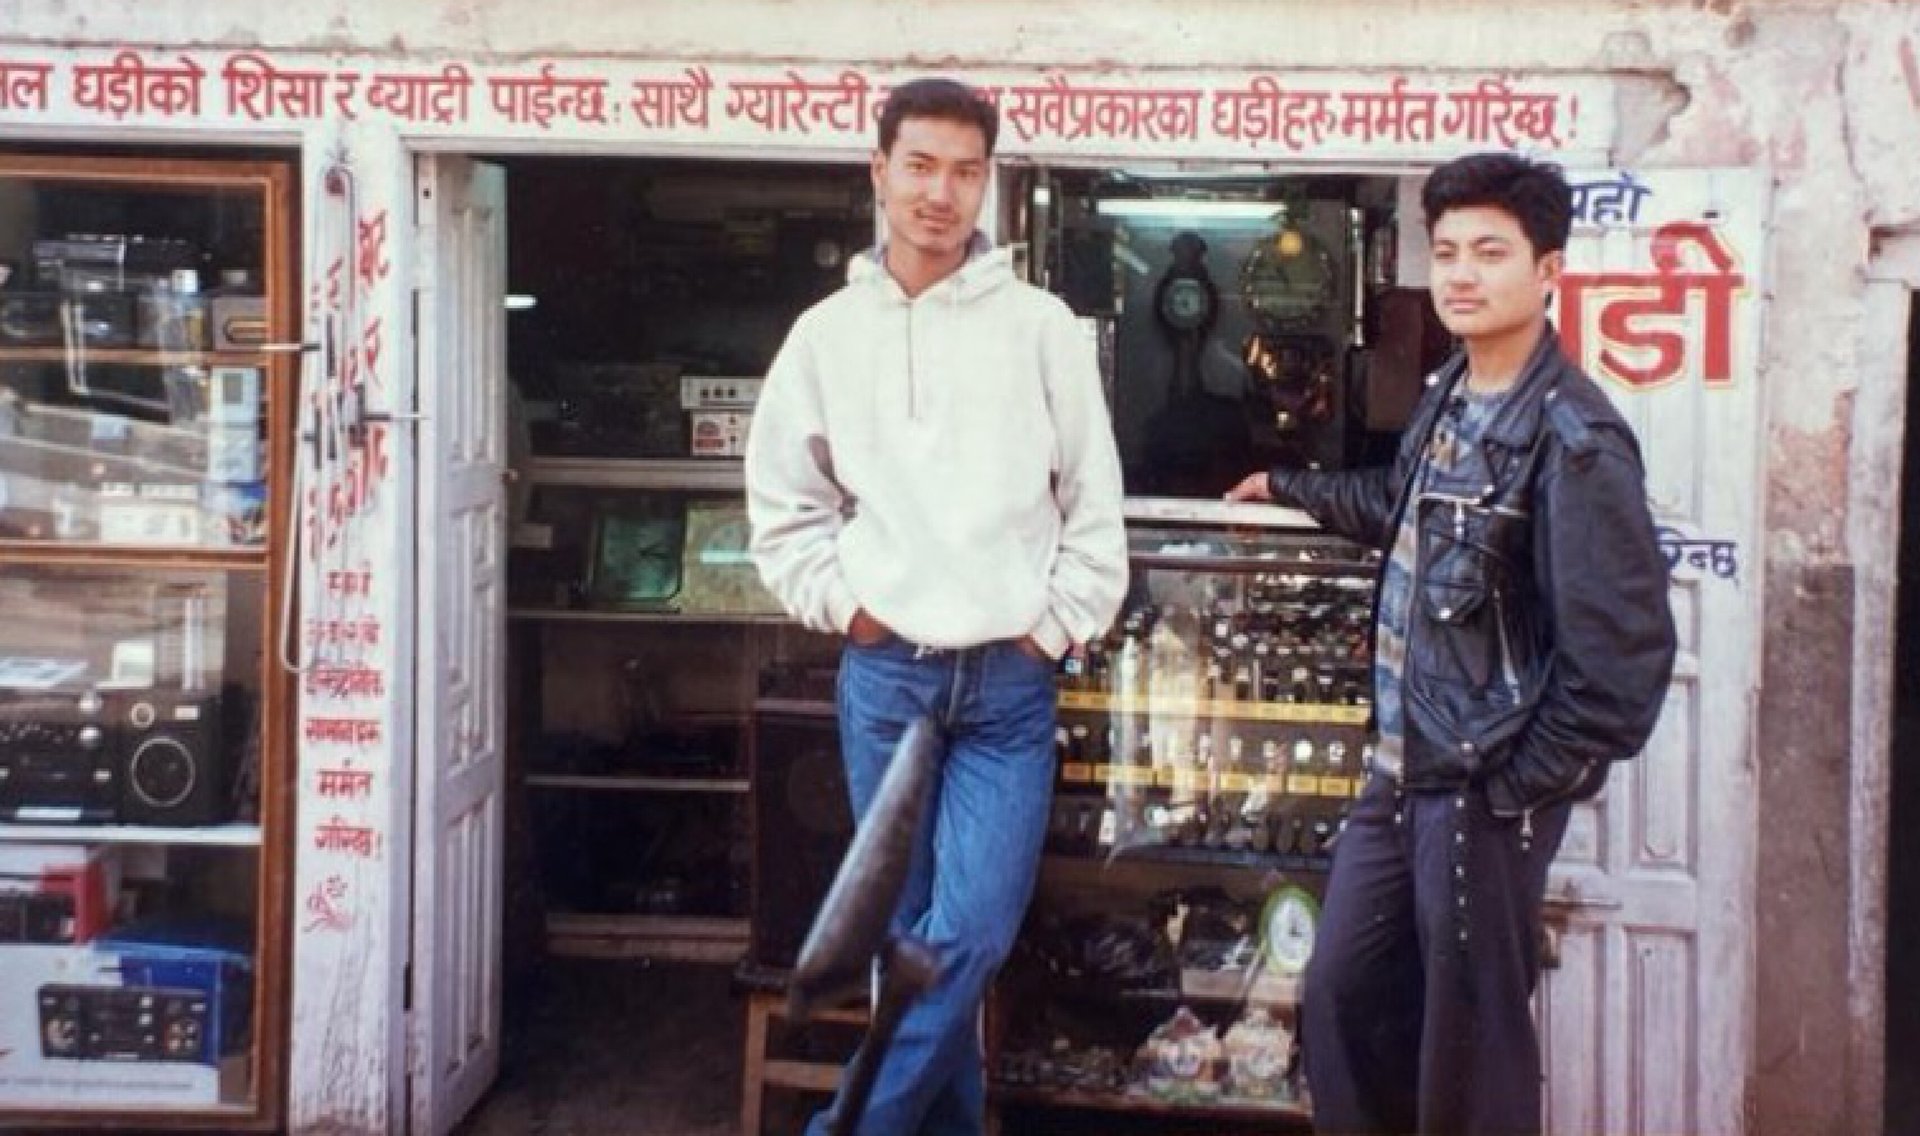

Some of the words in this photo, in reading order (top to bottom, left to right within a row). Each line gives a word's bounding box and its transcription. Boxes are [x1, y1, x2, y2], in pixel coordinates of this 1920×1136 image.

[0, 60, 54, 110] ल
[221, 54, 327, 120] शिसा
[335, 71, 360, 119] र
[631, 68, 714, 128] साथै
[726, 70, 870, 132] ग्यारेन्टी
[1340, 77, 1438, 143] मर्मत
